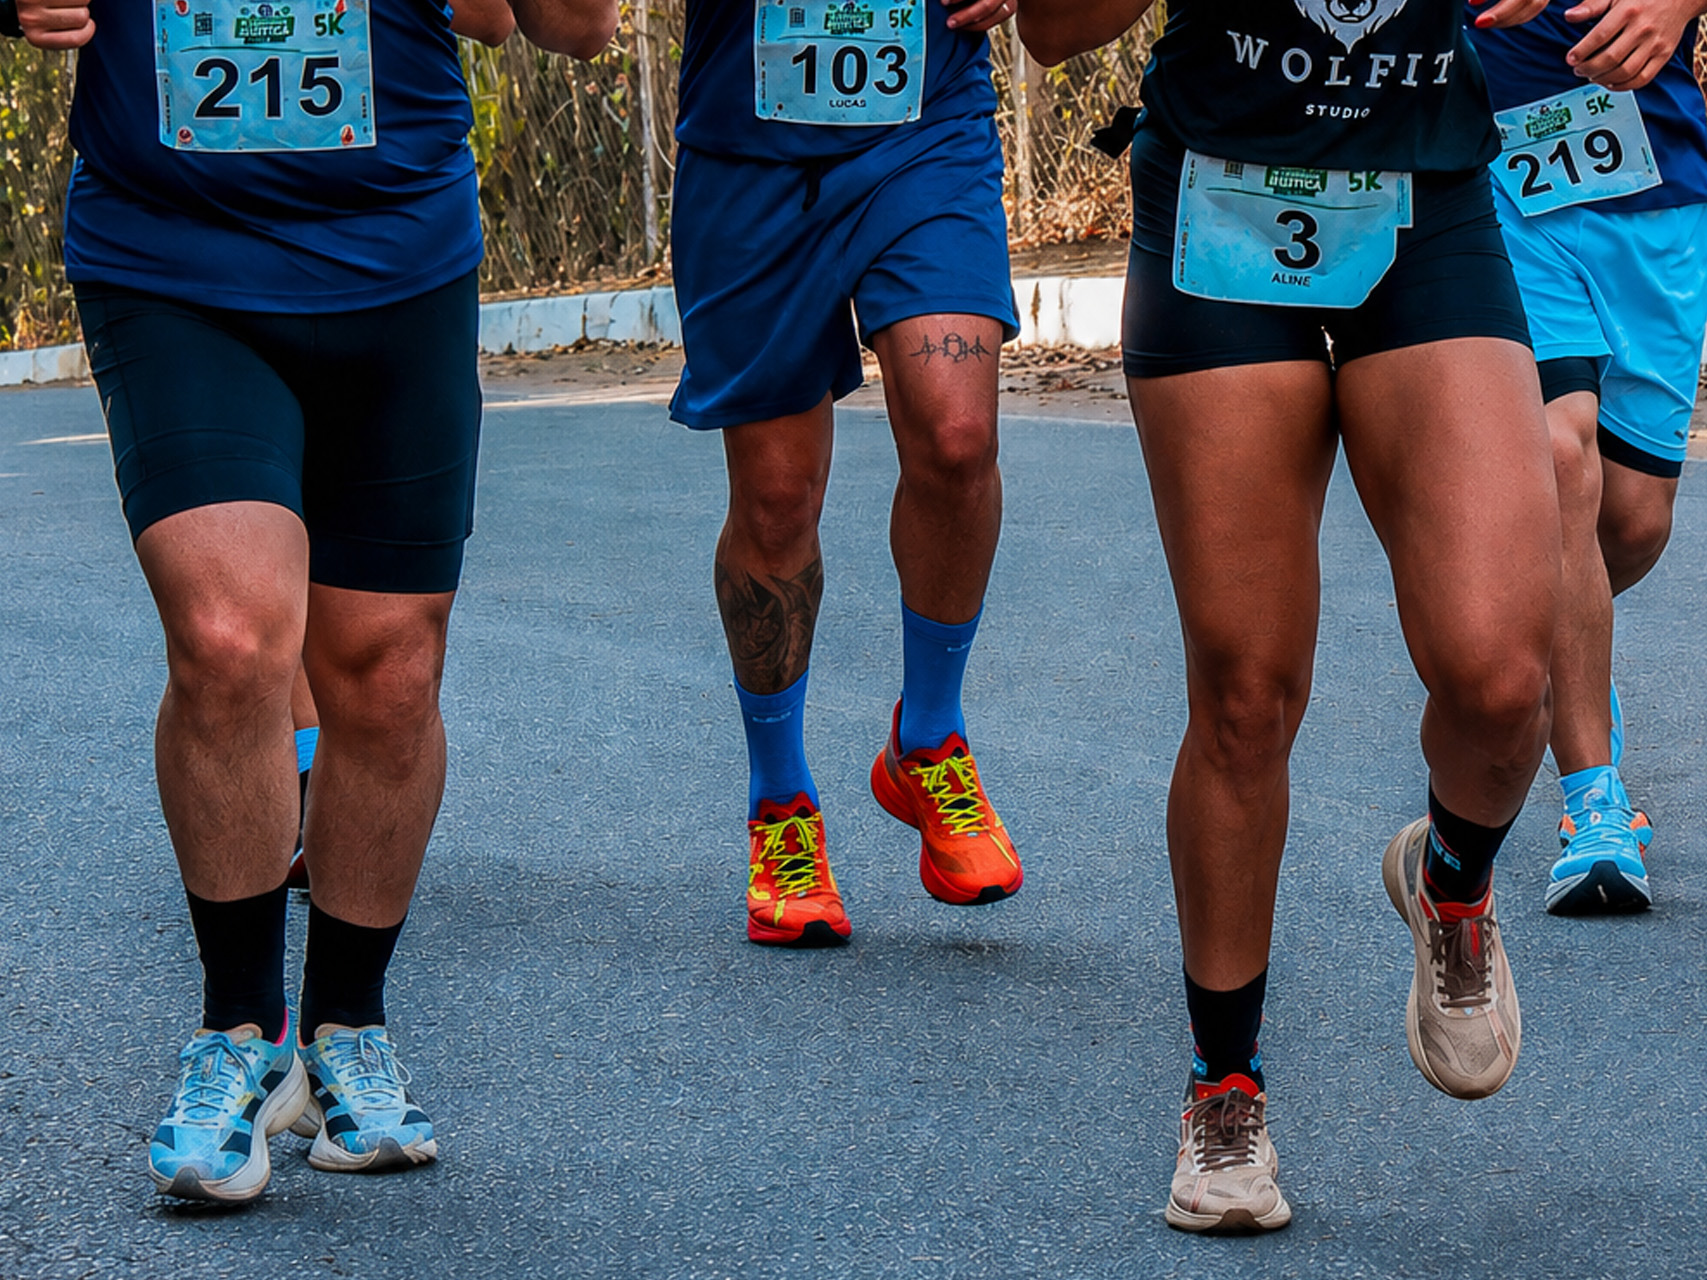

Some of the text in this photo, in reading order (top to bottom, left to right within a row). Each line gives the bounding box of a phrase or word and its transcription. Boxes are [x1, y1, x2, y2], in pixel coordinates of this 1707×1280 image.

[314, 11, 345, 37] 5K
[888, 8, 913, 29] 5K
[791, 44, 909, 96] 103
[1226, 29, 1455, 89] WOLFIT
[193, 56, 343, 119] 215
[828, 99, 867, 108] LUCAS
[1305, 103, 1371, 119] STUDIO
[1585, 93, 1615, 116] 5K
[1507, 128, 1624, 198] 219
[1348, 170, 1383, 193] 5K
[1273, 210, 1322, 270] 3
[1271, 272, 1313, 287] ALINE
